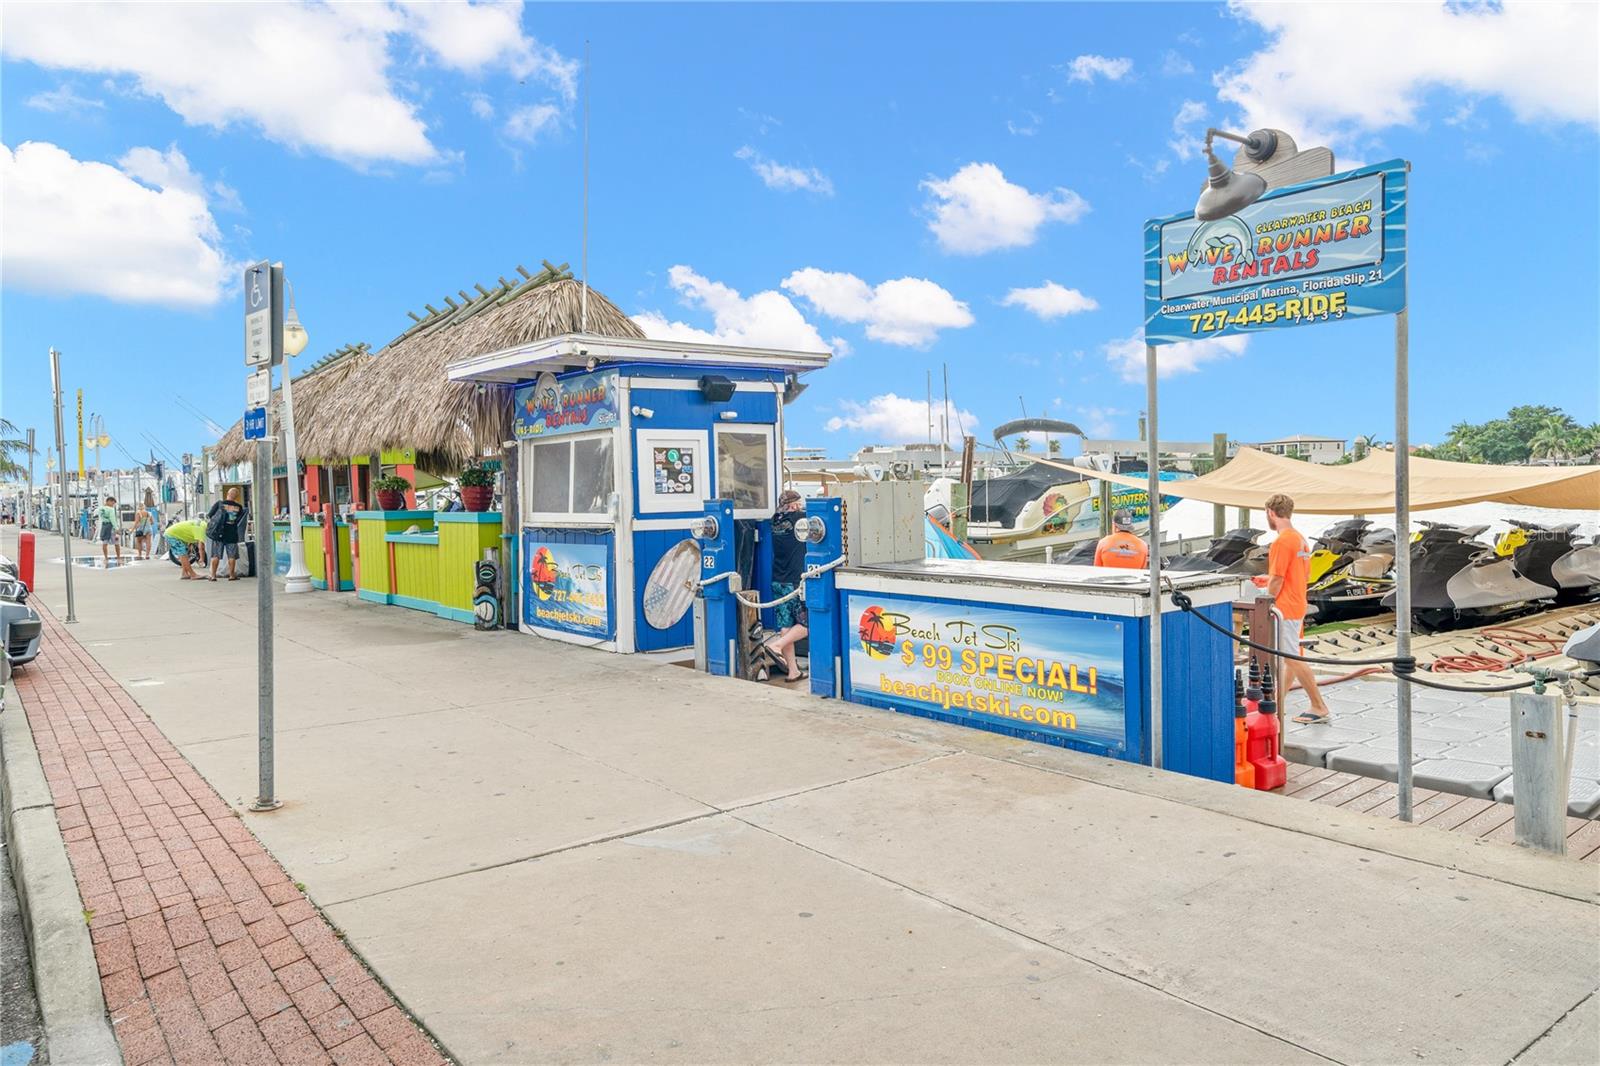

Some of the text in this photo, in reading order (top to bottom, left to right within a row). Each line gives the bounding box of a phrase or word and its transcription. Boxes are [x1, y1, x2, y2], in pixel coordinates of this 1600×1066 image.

[1255, 200, 1372, 234] CLEARWATER BEACH
[1257, 215, 1371, 256] RUNNER
[1212, 248, 1320, 285] RENTALS
[1160, 270, 1383, 315] Clearwater Municipal Marina, Florida Slip 21
[1189, 292, 1347, 334] 727-445-RIDE
[562, 384, 606, 408] RUNNER
[1092, 493, 1149, 512] EOUNTERS
[704, 557, 714, 567] 22
[536, 607, 601, 627] beachjetski.com
[882, 613, 1021, 653] Beach Jet Ski
[901, 639, 1098, 696] $ 99 SPECIAL!
[879, 673, 1077, 730] beachjetski.com
[936, 670, 1064, 703] BOOK ONLINE NOW!
